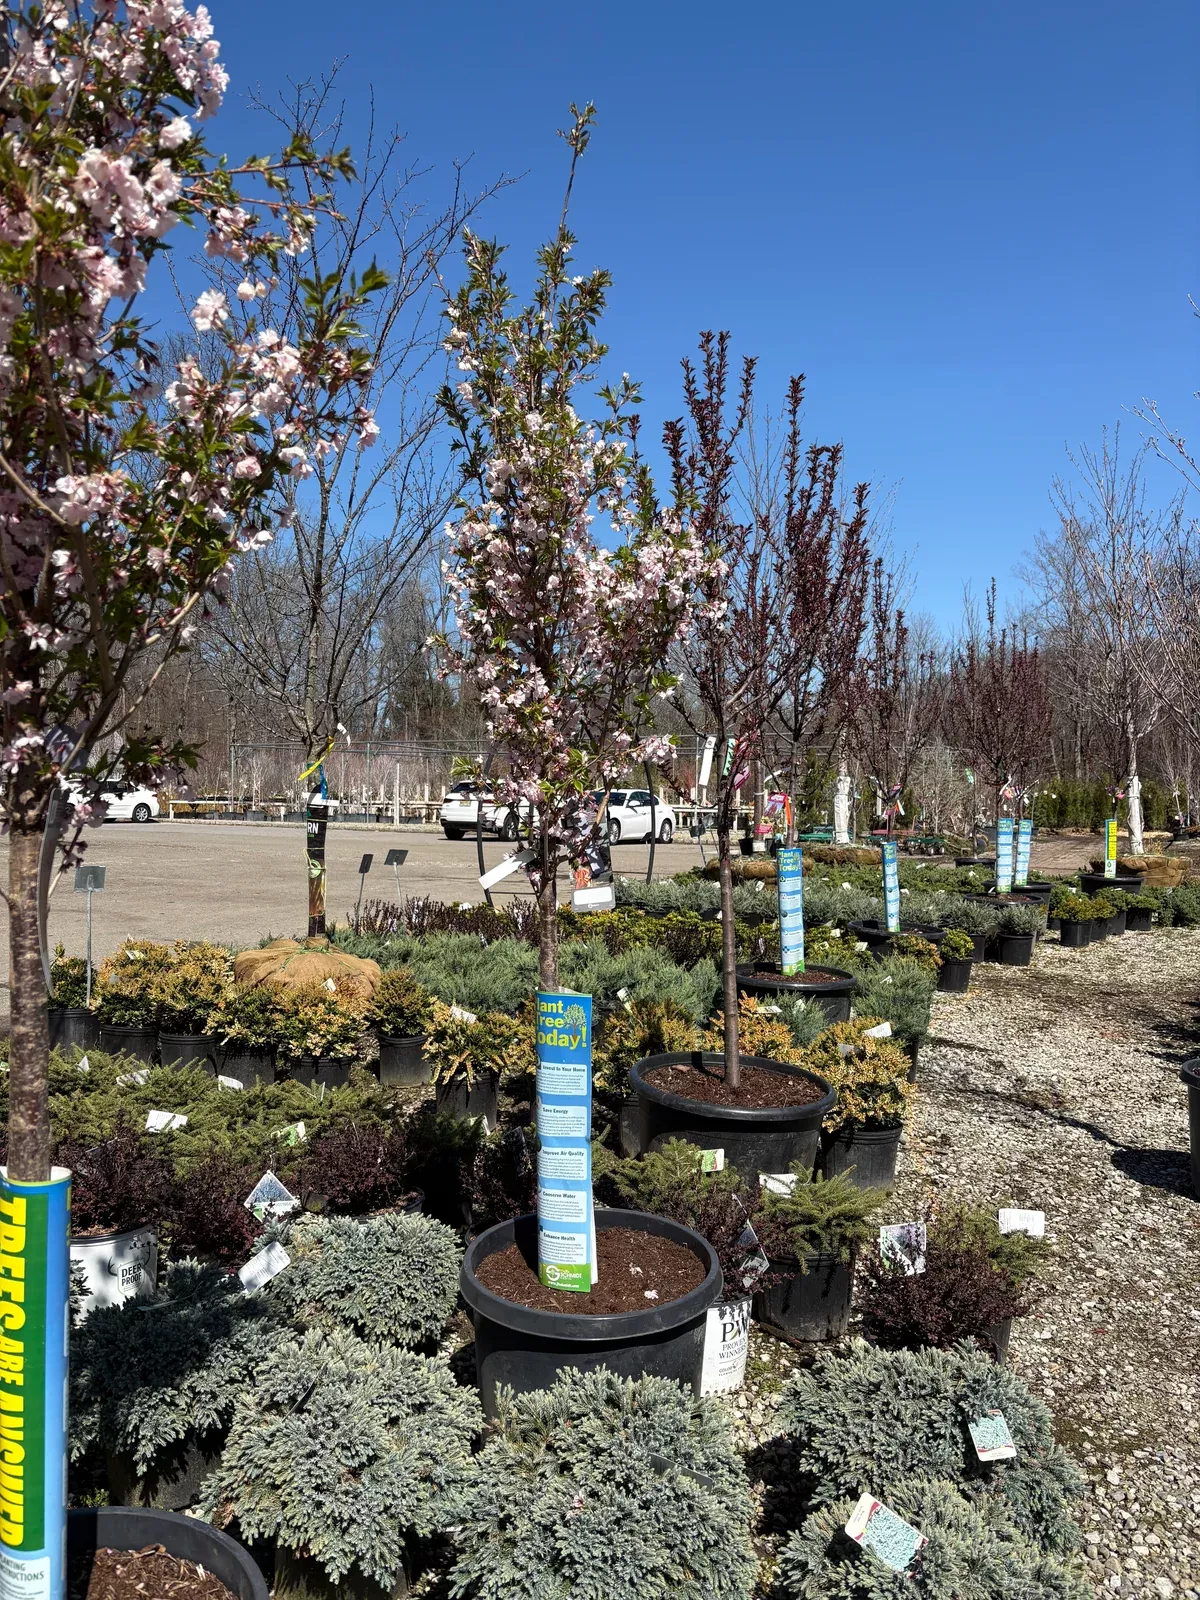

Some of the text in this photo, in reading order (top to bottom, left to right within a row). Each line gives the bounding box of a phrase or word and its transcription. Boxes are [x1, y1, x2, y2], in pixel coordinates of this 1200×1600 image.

[308, 822, 319, 834] RN
[537, 998, 564, 1014] lant
[537, 1026, 587, 1050] oday!
[122, 1263, 142, 1277] DEER
[122, 1272, 141, 1286] PROOF
[720, 1318, 748, 1343] PW
[723, 1337, 746, 1351] PROVEN
